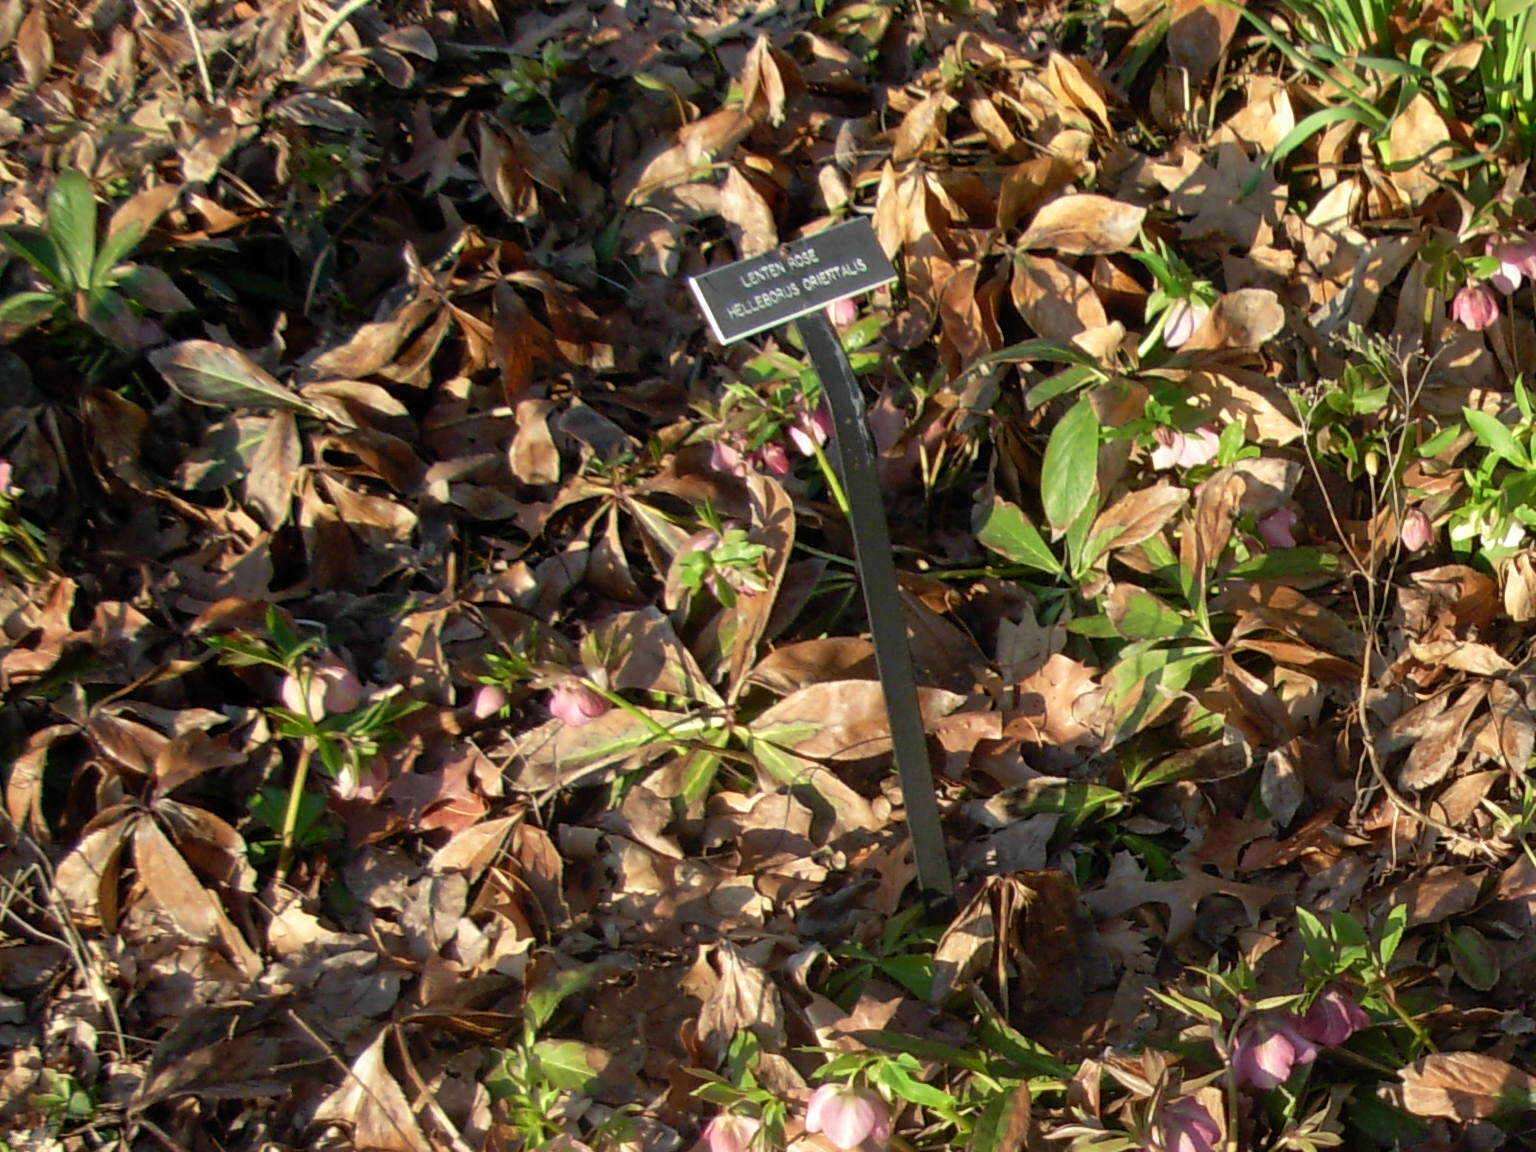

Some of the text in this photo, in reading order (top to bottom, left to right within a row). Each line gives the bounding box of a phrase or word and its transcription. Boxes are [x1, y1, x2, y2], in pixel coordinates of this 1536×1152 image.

[727, 258, 867, 319] HELLEBORUS ORIENTALIS
[740, 249, 820, 288] LENTEN ROSE
